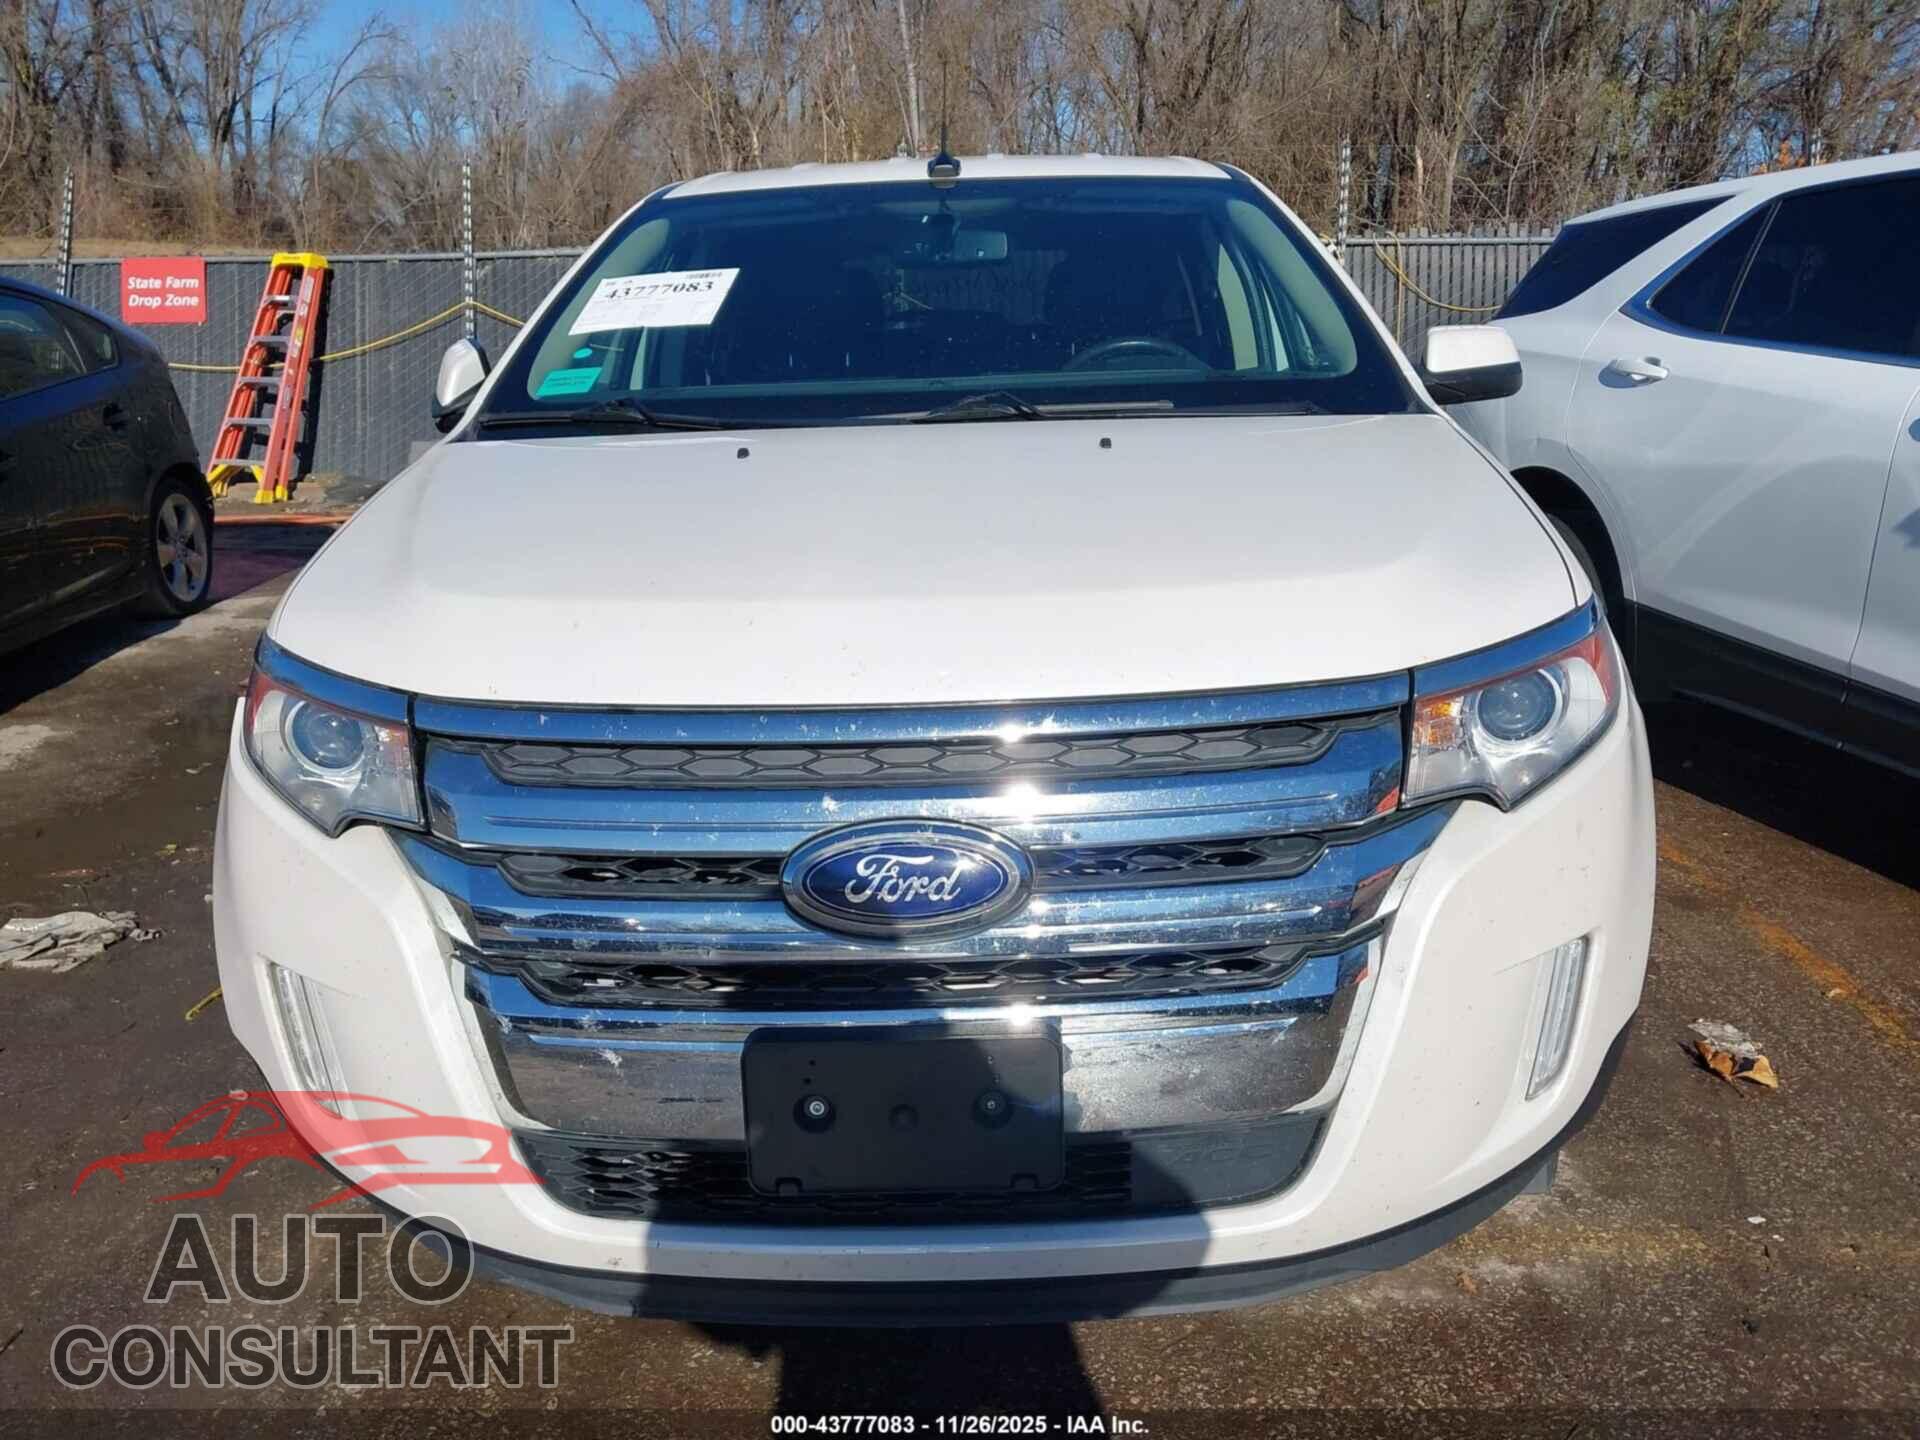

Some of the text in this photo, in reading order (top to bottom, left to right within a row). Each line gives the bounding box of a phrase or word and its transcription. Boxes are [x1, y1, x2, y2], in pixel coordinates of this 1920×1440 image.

[127, 276, 199, 289] State Farm
[605, 280, 714, 299] 43777083
[128, 293, 199, 309] Drop Zone
[844, 853, 962, 903] Ford
